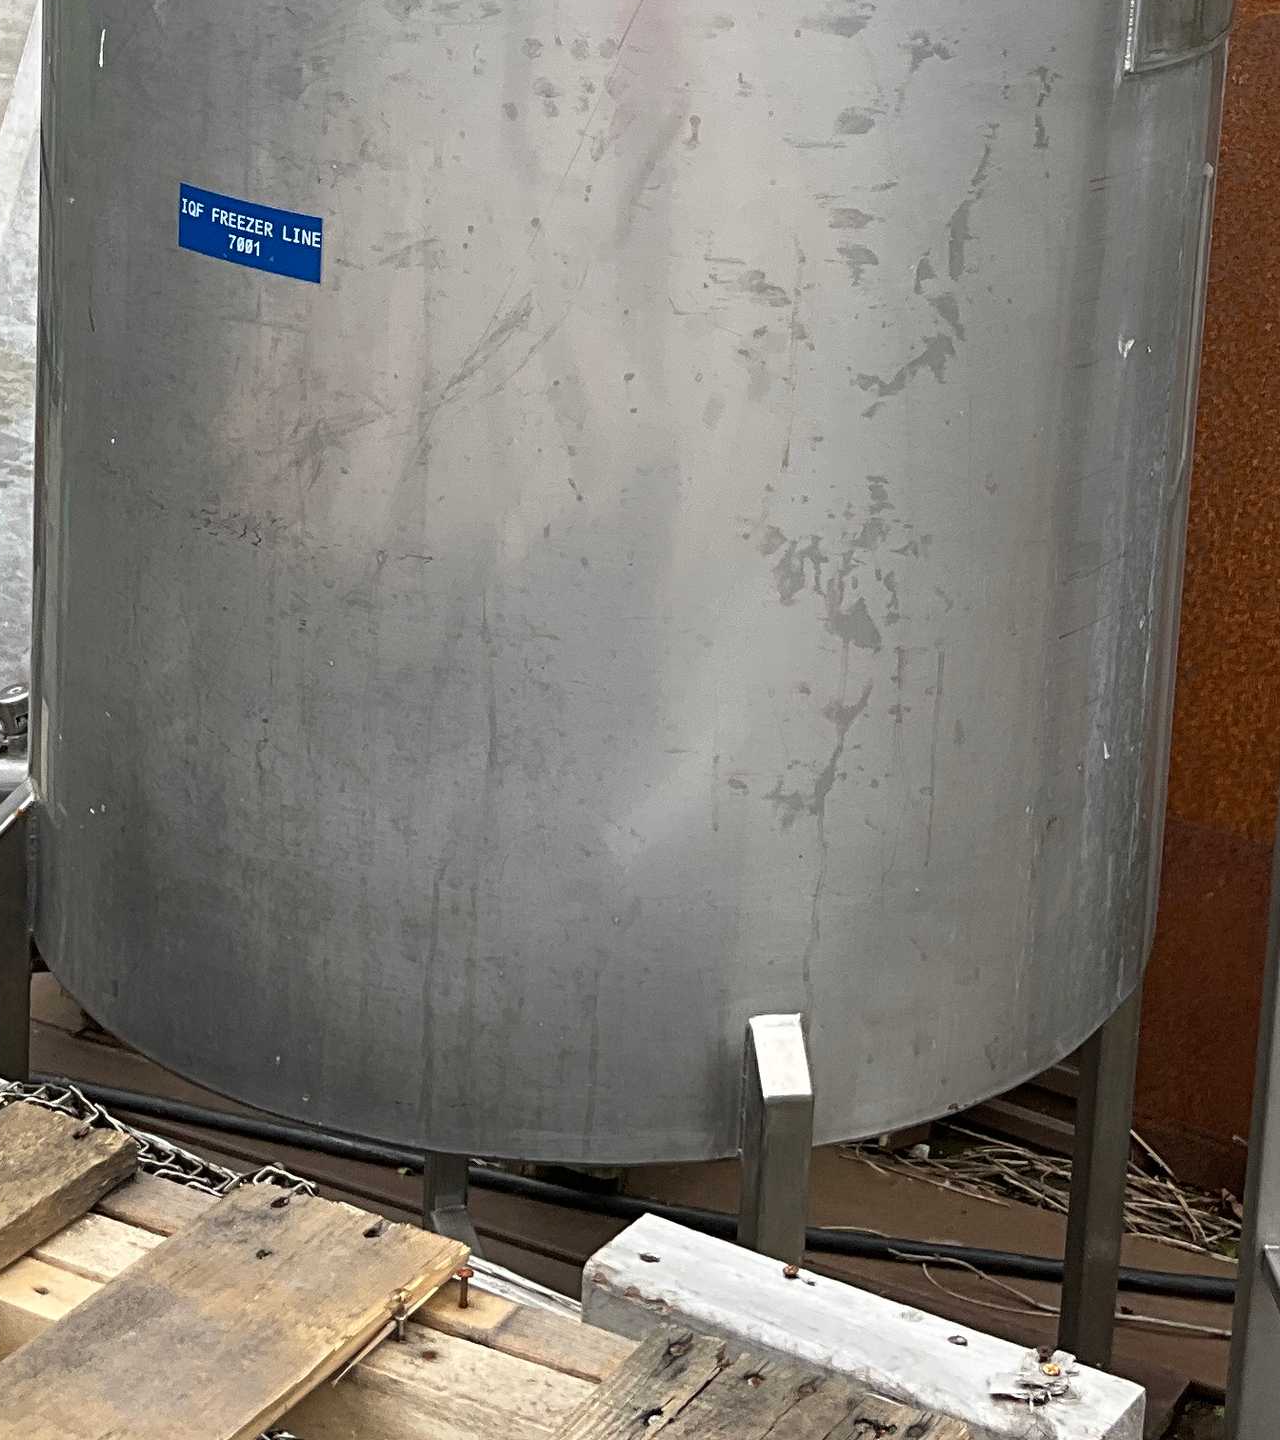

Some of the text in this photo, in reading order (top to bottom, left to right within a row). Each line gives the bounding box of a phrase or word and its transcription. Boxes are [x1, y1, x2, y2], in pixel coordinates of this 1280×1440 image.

[181, 198, 321, 248] IQF FREEZER LINE
[228, 234, 261, 257] 7001
